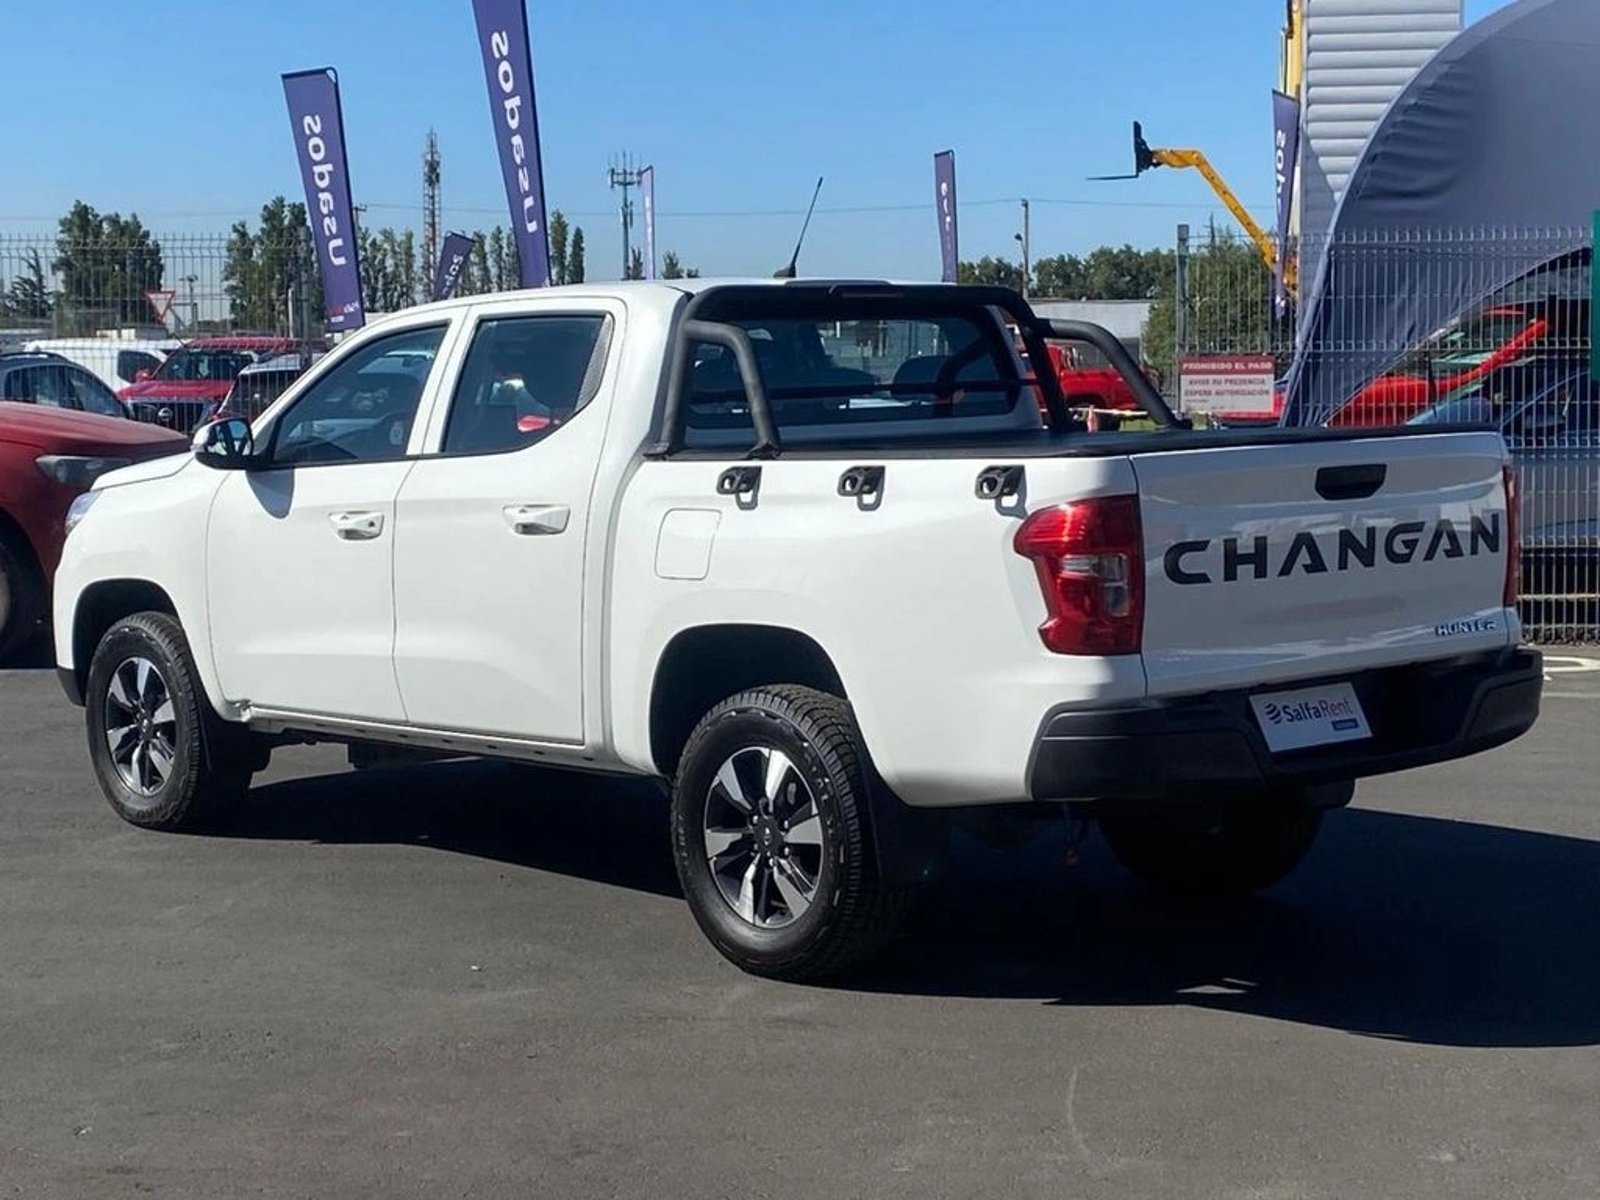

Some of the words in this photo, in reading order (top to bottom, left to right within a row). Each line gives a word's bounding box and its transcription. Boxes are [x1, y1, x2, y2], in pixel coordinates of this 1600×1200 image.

[1183, 362, 1232, 370] PROHIBIDO
[1235, 362, 1246, 370] EL
[1248, 362, 1273, 370] PASO
[1164, 513, 1500, 585] CHANGAN
[1435, 620, 1497, 636] HUNTER
[1282, 699, 1354, 722] SalfaRent
